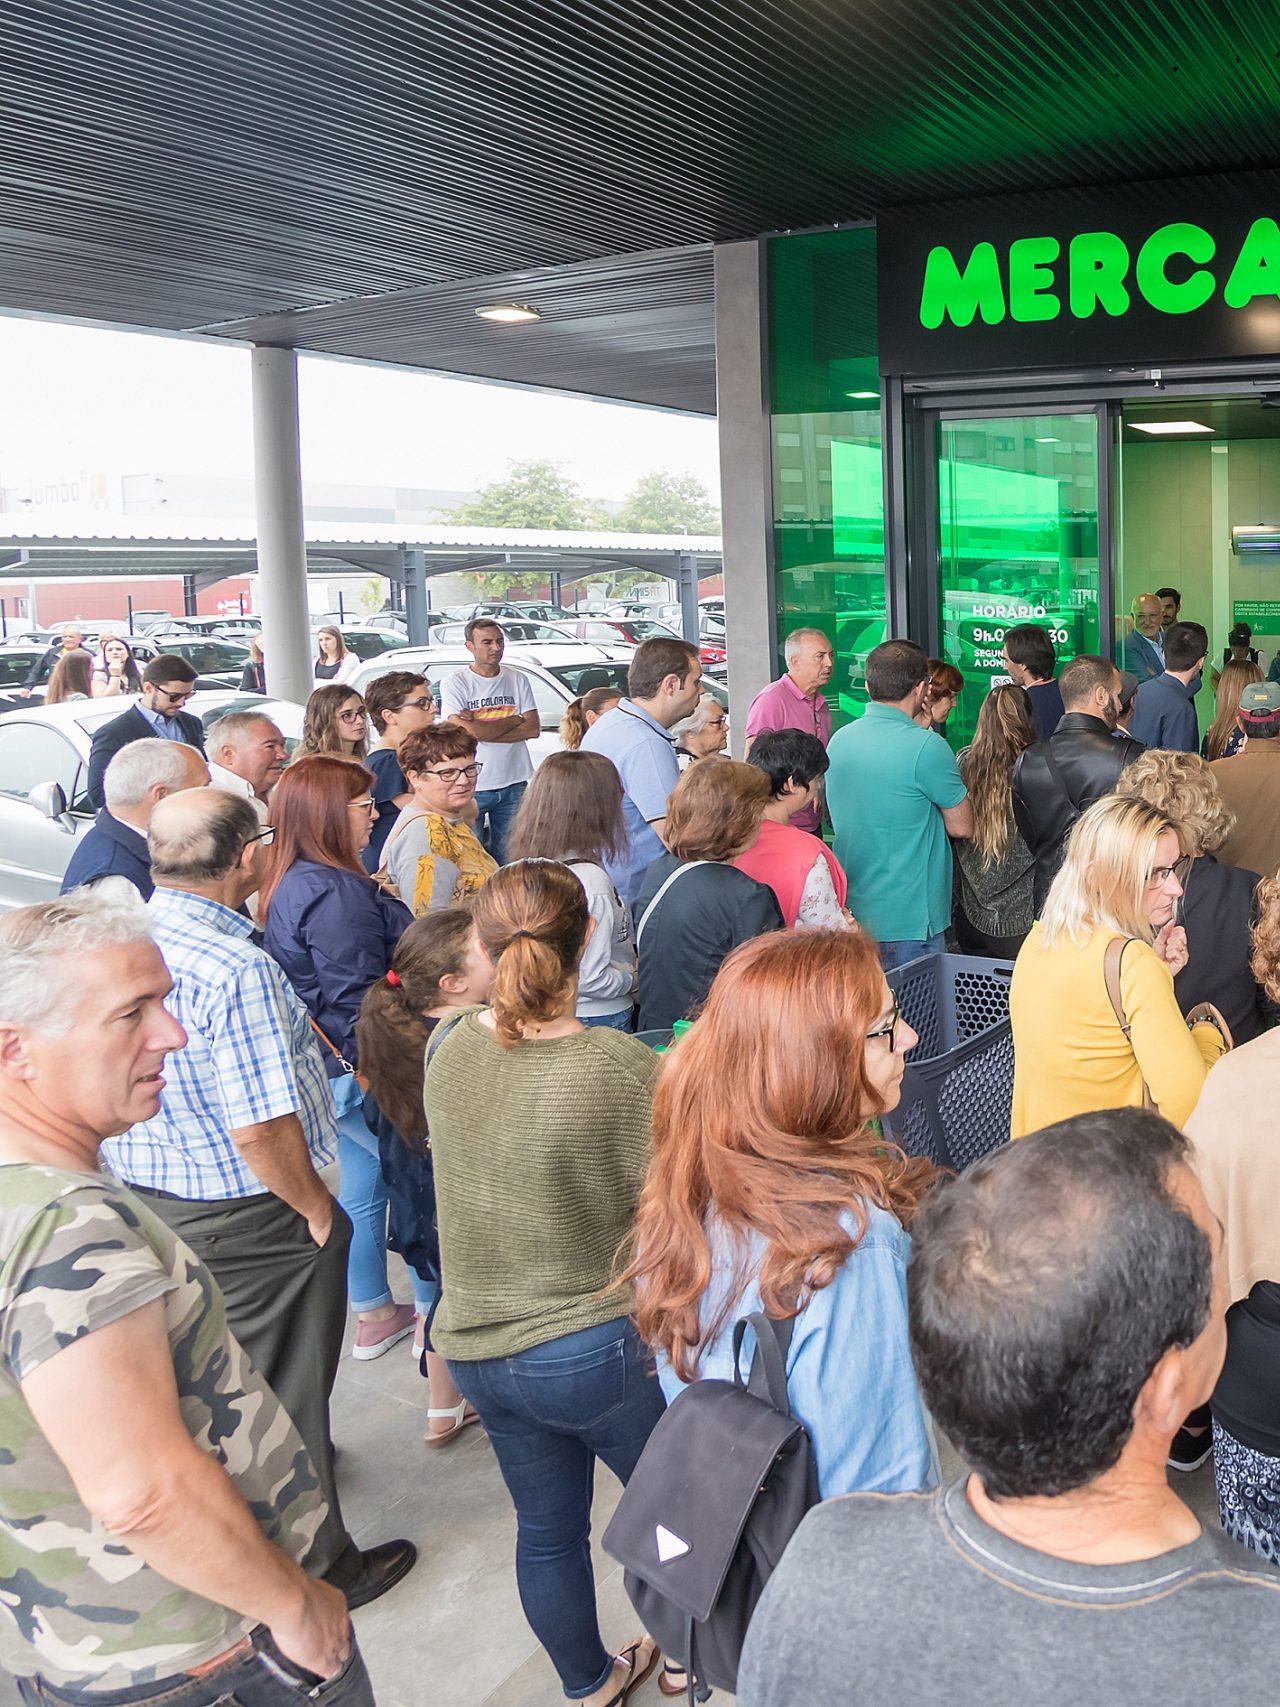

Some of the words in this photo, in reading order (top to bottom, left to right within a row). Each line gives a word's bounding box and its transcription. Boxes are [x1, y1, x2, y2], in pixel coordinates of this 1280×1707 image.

[973, 628, 1011, 642] 9h.0
[974, 649, 1004, 658] SEGUN
[974, 659, 982, 667] A
[983, 659, 1006, 668] DOMI
[467, 699, 480, 710] THE
[481, 695, 503, 707] COLOR
